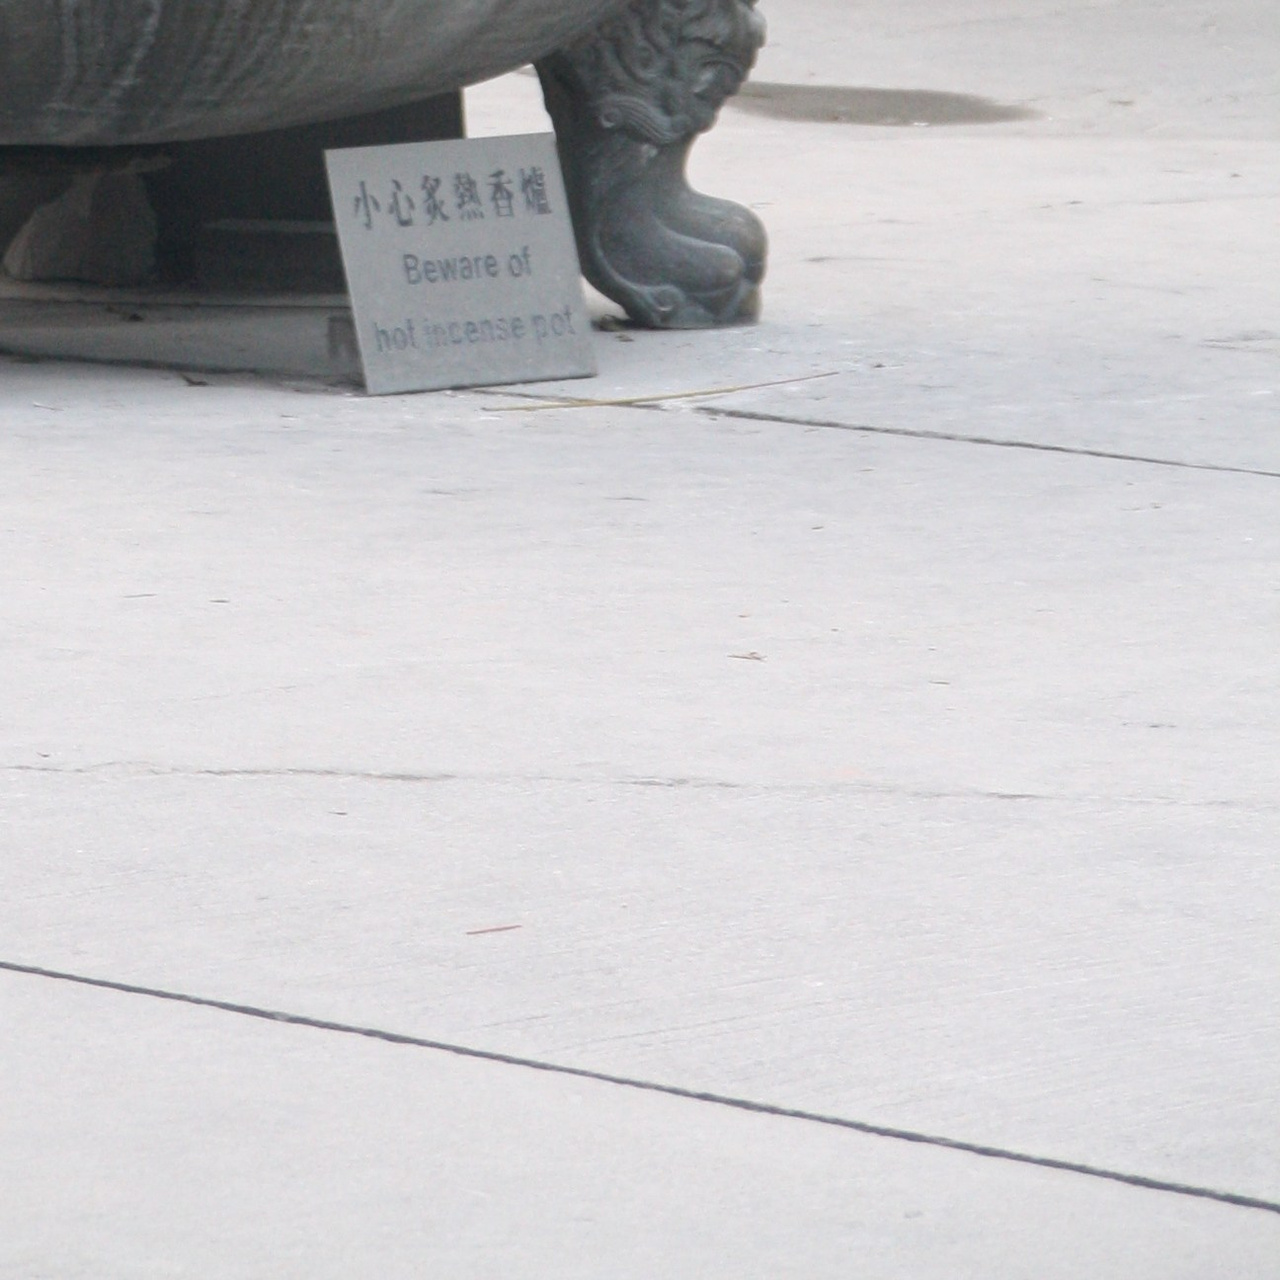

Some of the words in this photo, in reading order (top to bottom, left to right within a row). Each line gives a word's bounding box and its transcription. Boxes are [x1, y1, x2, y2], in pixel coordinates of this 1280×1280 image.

[403, 253, 500, 285] Beware
[508, 245, 532, 278] of
[373, 318, 419, 353] hot
[423, 315, 526, 350] incense
[530, 304, 576, 345] pot
